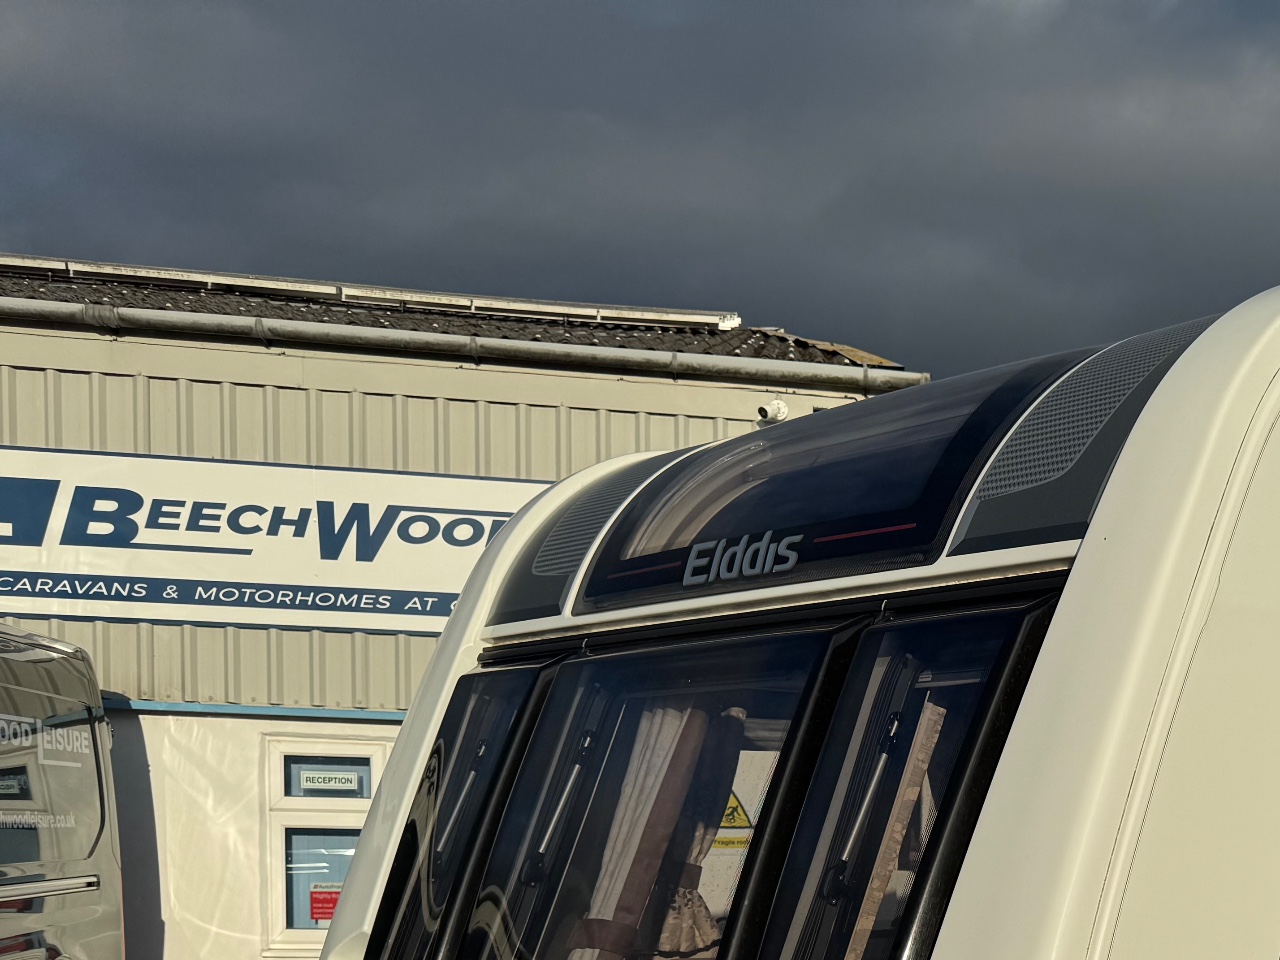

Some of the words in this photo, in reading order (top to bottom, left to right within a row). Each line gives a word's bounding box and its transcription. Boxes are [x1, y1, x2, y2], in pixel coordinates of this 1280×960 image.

[59, 485, 507, 563] BEECHWOO
[682, 530, 804, 587] Elddis
[0, 577, 147, 597] CARAVANS
[162, 585, 179, 600] &
[195, 586, 391, 610] MOTORHOMES
[404, 596, 438, 612] AT
[37, 717, 90, 767] LEISURE
[305, 775, 353, 786] RECEPTION
